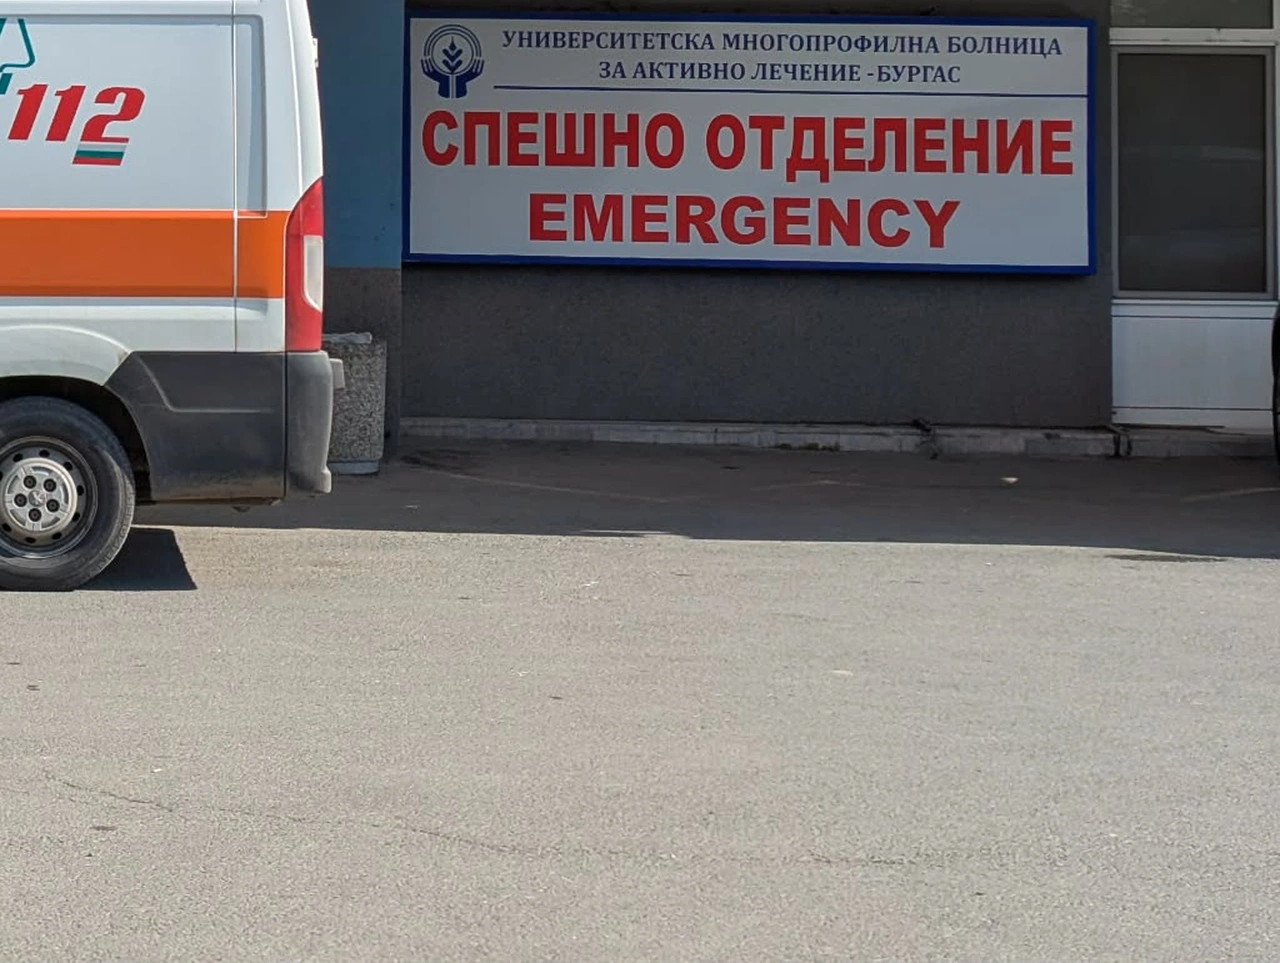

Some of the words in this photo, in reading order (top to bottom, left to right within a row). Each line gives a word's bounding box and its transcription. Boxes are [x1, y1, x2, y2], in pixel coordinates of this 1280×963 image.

[502, 30, 715, 52] УНИВЕРСИТЕТСКА
[721, 33, 940, 55] МНОГОПРОФИЛНА
[947, 36, 1062, 59] БОЛНИЦА
[599, 61, 625, 79] ЗА
[632, 62, 746, 81] АКТИВНО
[750, 63, 861, 82] ЛЕЧЕНИЕ
[7, 83, 145, 144] 112
[421, 110, 685, 169] СПЕШНО
[706, 114, 1074, 183] ОТДЕЛЕНИЕ
[529, 193, 961, 249] EMERGENCY
